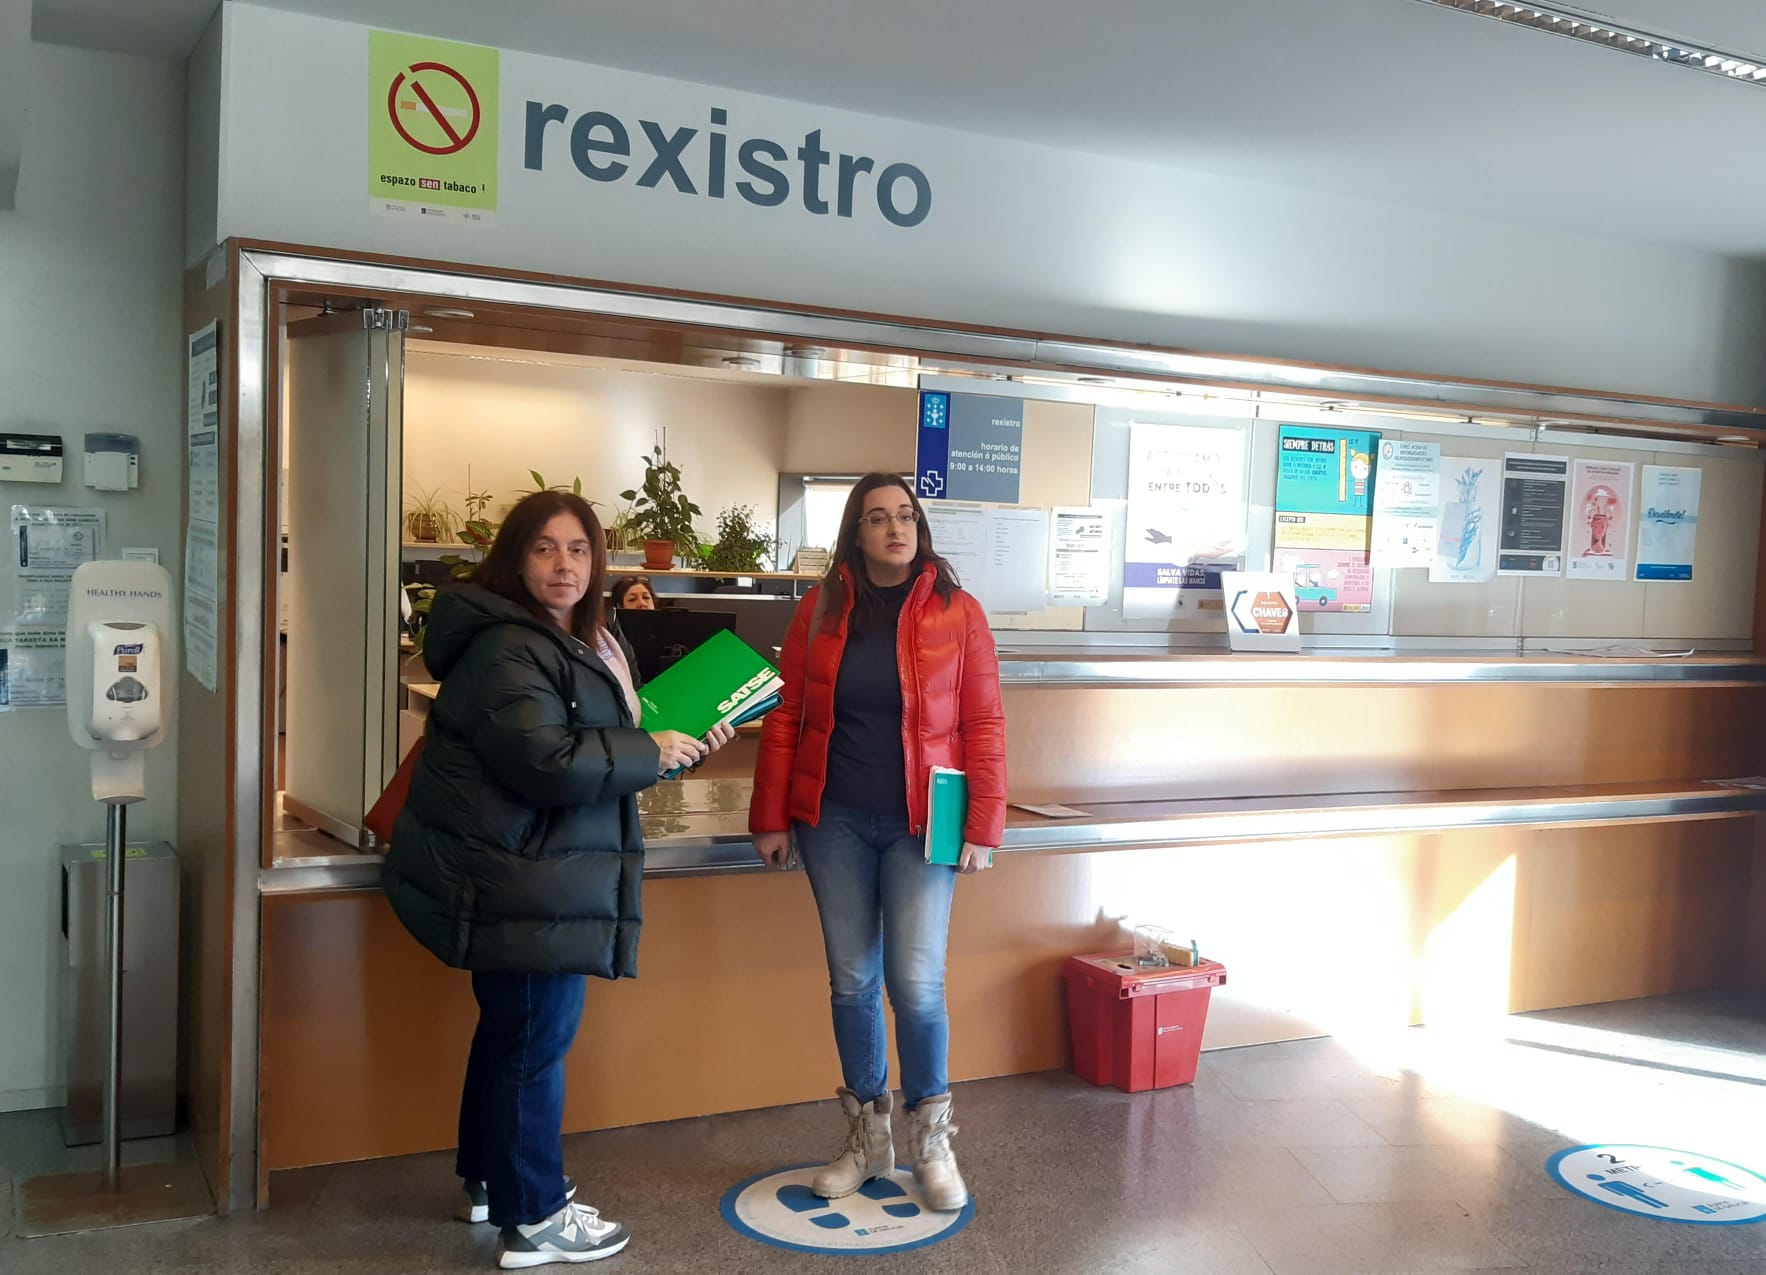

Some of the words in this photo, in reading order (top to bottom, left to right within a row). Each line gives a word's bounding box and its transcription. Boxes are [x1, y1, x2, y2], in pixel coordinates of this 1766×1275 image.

[524, 100, 932, 228] rexistro
[380, 174, 416, 187] espazo
[421, 179, 439, 190] sen
[444, 181, 477, 194] tabaco
[991, 417, 1021, 428] rexistro
[981, 442, 1009, 452] horario
[1010, 444, 1019, 453] de
[1283, 439, 1310, 451] SIEMPRE
[951, 450, 983, 460] atención
[992, 451, 1019, 462] público
[950, 462, 967, 471] 9:00
[975, 464, 995, 473] 14:00
[996, 465, 1018, 474] horas
[1157, 568, 1181, 576] SALVA
[87, 588, 127, 598] HEALTHY
[129, 589, 162, 598] HANDS
[717, 666, 776, 714] SATSE
[1597, 1153, 1626, 1165] 2
